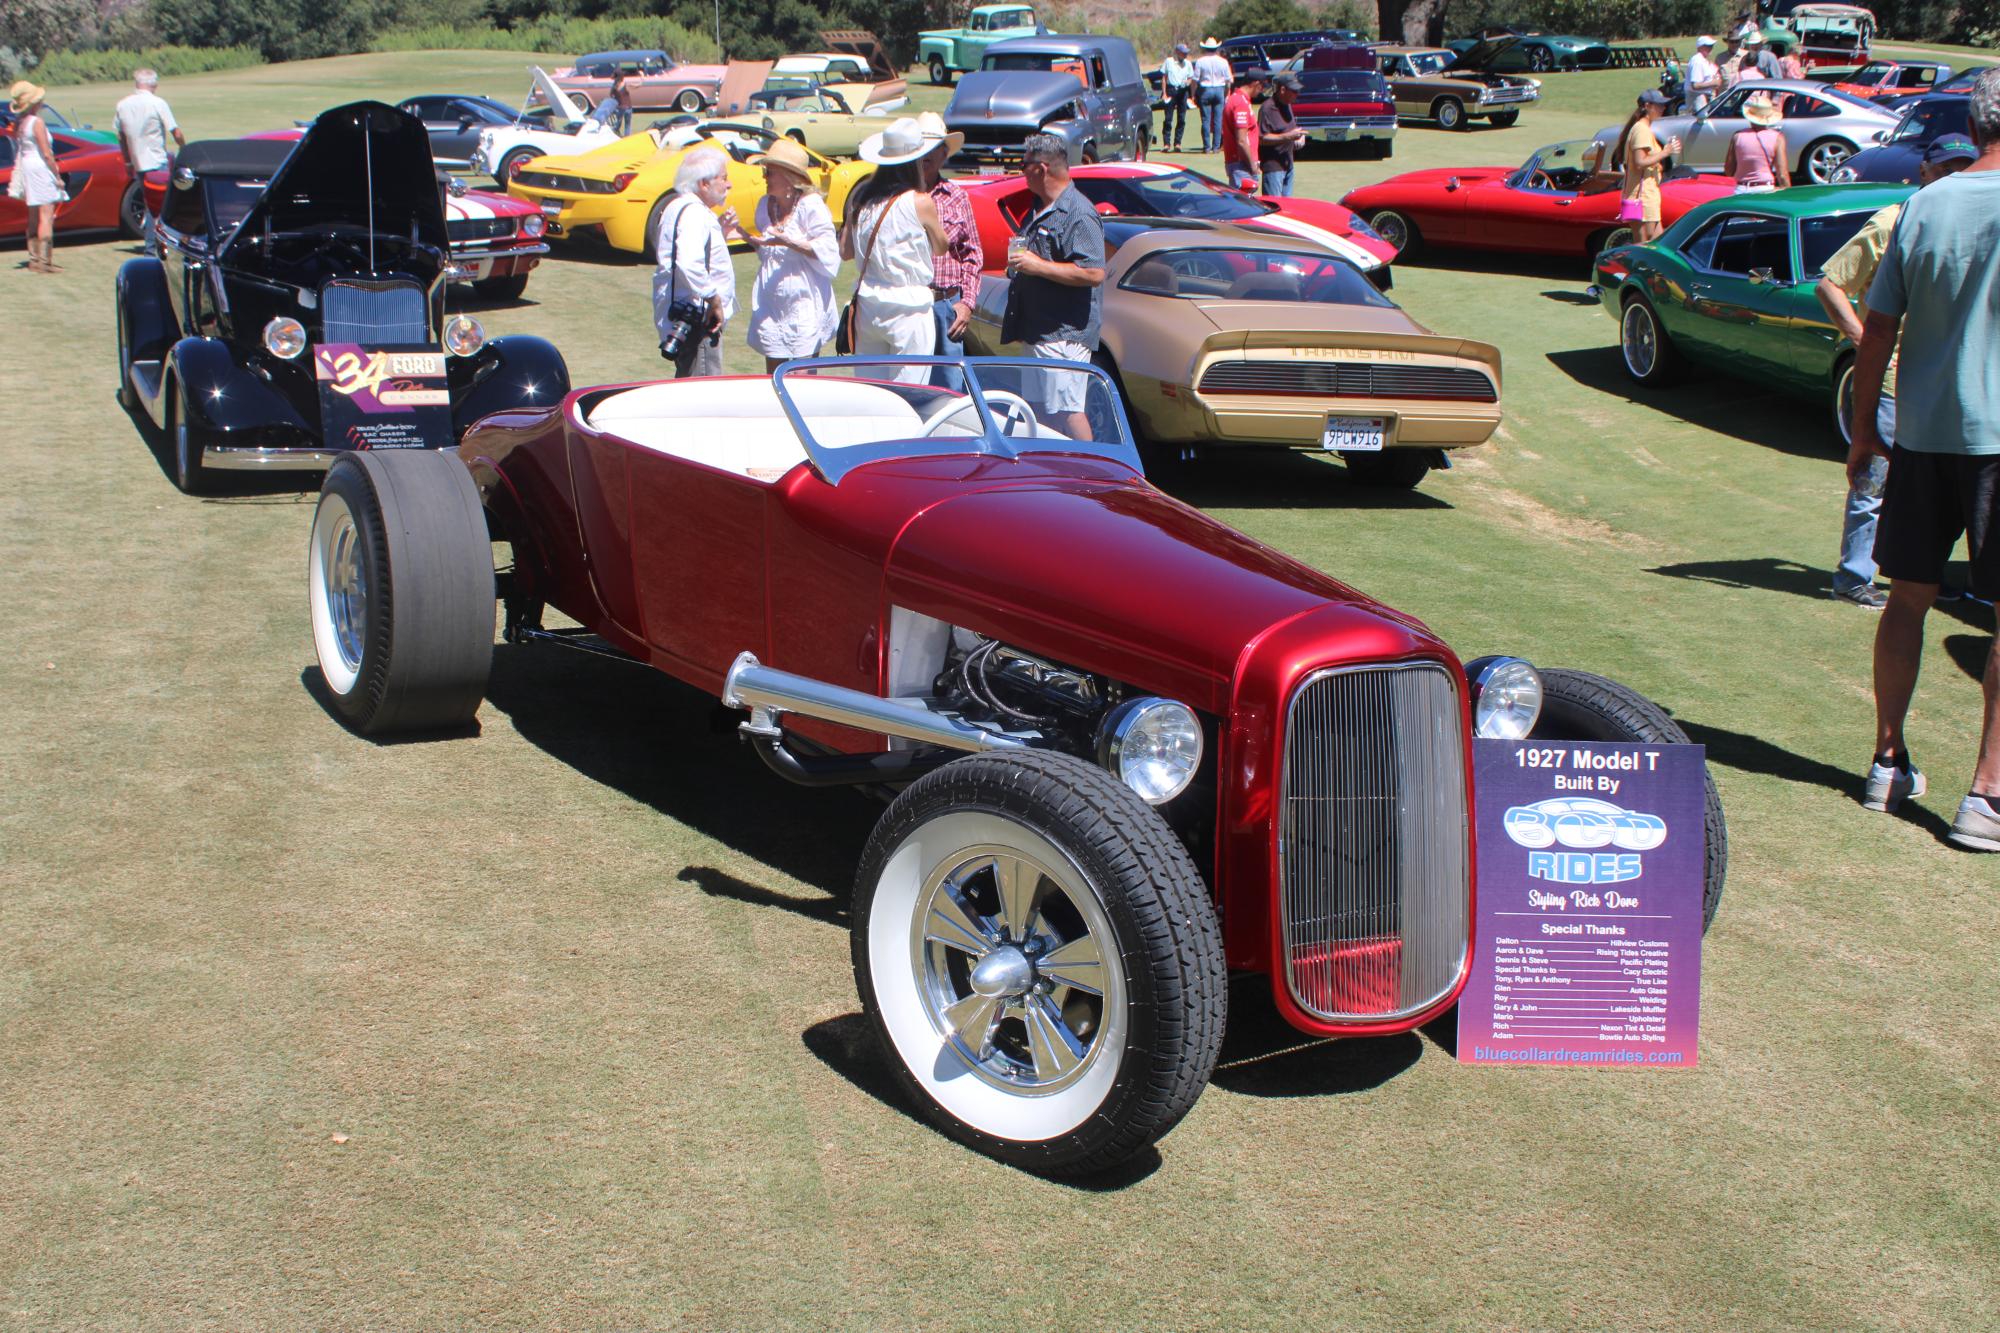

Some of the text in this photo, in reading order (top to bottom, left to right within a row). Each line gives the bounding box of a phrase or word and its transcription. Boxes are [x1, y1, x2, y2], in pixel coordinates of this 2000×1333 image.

[320, 350, 437, 398] '34 FORD
[1329, 429, 1380, 445] 9PCW916
[1515, 748, 1660, 771] 1927 Model T
[1554, 775, 1619, 794] Built By
[1528, 851, 1642, 884] RIDES
[1528, 889, 1566, 910] Styling
[1542, 923, 1626, 935] Special Thanks
[1496, 937, 1519, 945] Dalton
[1525, 947, 1544, 955] Dave
[1596, 949, 1619, 958] Rising
[1620, 958, 1643, 966] Pacific
[1644, 959, 1668, 967] Plating
[1495, 966, 1521, 974] Special
[1523, 966, 1548, 974] Thanks
[1642, 968, 1668, 976] Electric
[1515, 975, 1533, 984] Ryan
[1542, 976, 1571, 985] Anthony
[1494, 984, 1511, 992] Glen
[1494, 994, 1667, 1005] Roy Welding
[1494, 1003, 1511, 1012] Gary
[1610, 1005, 1641, 1013] Lakeside
[1628, 1015, 1666, 1023] Upholstery
[1624, 1024, 1638, 1032] Tint
[1599, 1033, 1623, 1041] Bowtie
[1641, 1034, 1665, 1043] Styling
[1474, 1046, 1683, 1063] bluecollardreamrides.com
